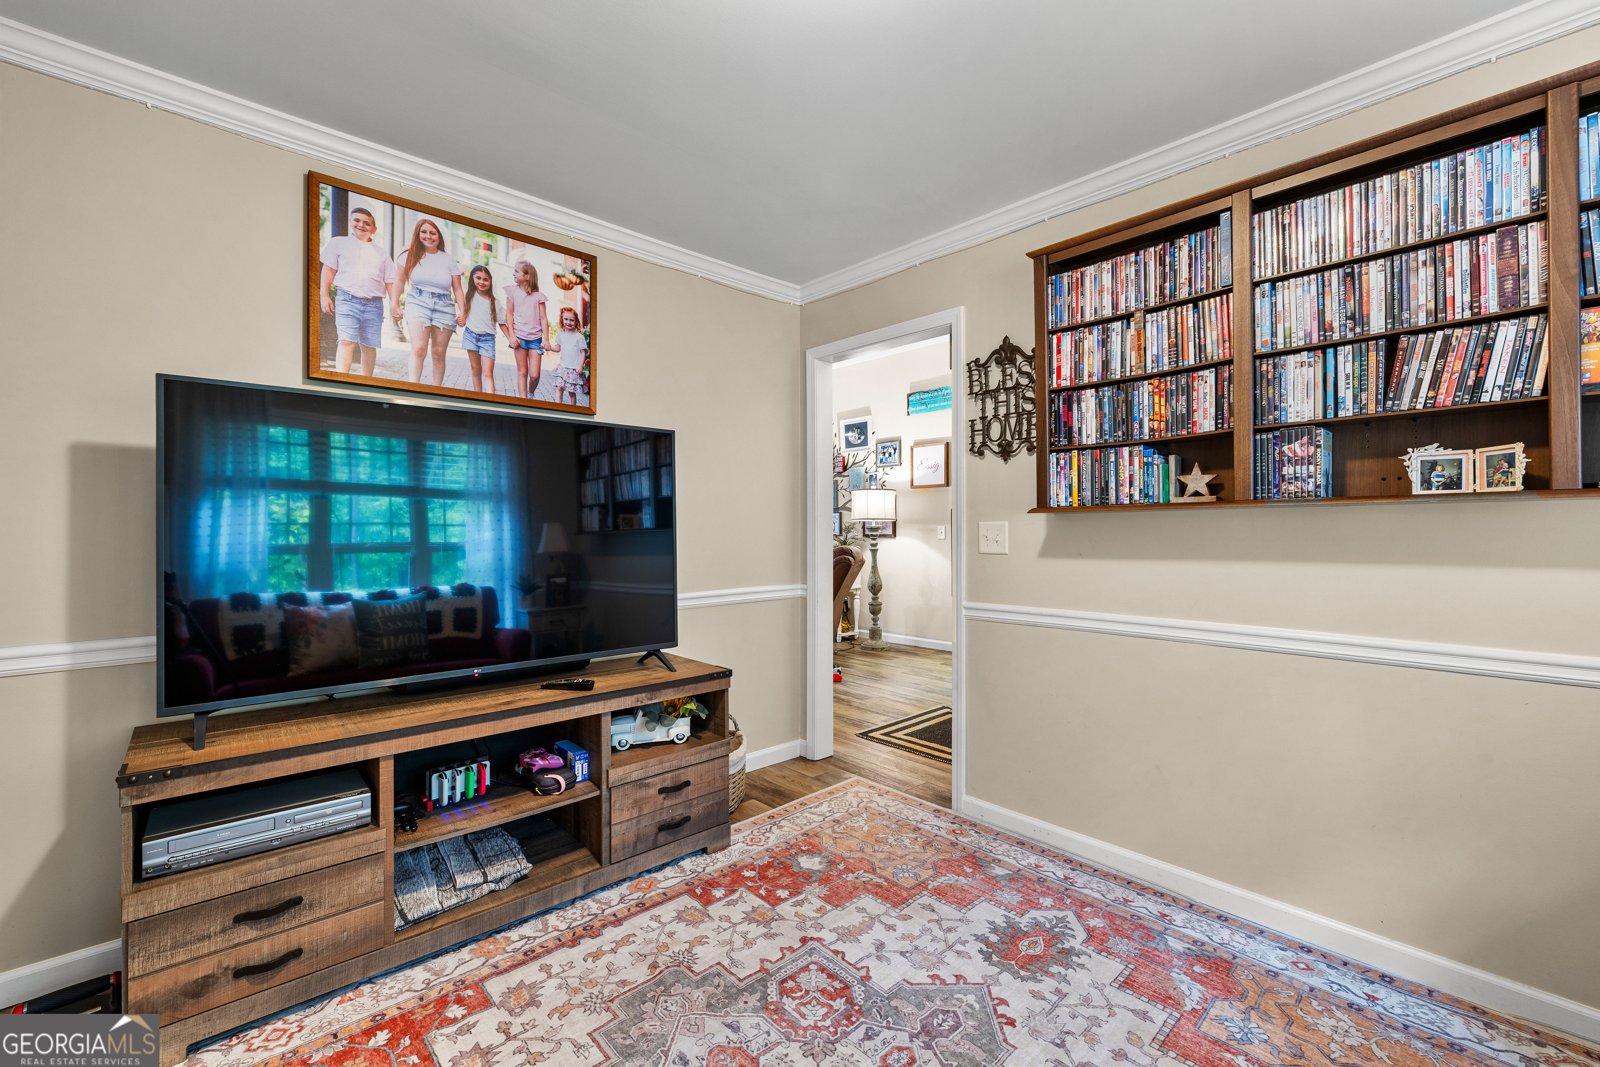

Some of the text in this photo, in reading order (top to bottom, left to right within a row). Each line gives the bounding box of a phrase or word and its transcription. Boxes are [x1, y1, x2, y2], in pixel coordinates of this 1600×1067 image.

[1436, 359, 1445, 371] STAY
[1500, 337, 1513, 374] TAKEN
[975, 386, 1036, 419] THIS
